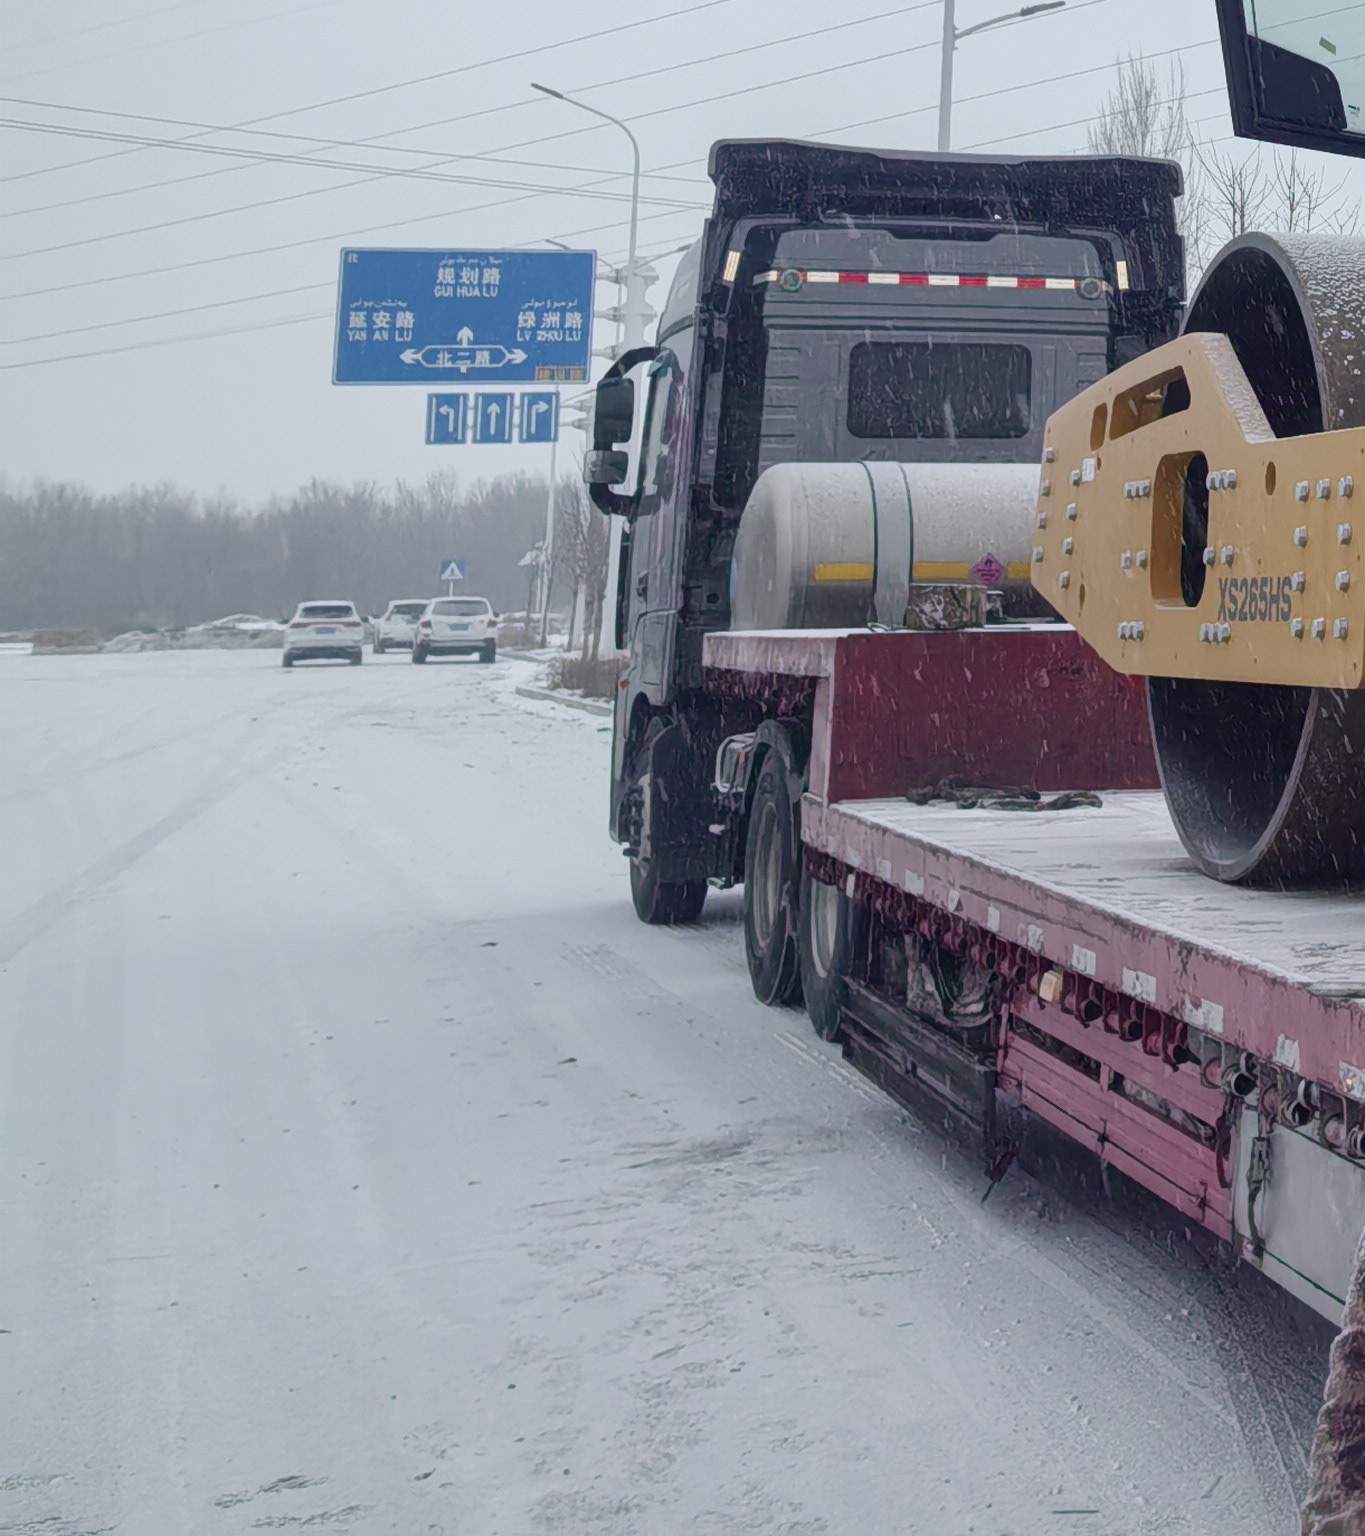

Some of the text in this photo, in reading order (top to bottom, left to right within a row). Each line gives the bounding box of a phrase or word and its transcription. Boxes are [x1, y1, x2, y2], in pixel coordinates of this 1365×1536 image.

[434, 285, 499, 298] GUI HUA LU
[517, 311, 583, 329] 绿洲路
[347, 329, 413, 342] YAN AN LU
[565, 330, 582, 342] LU
[1217, 575, 1293, 623] XS265HS
